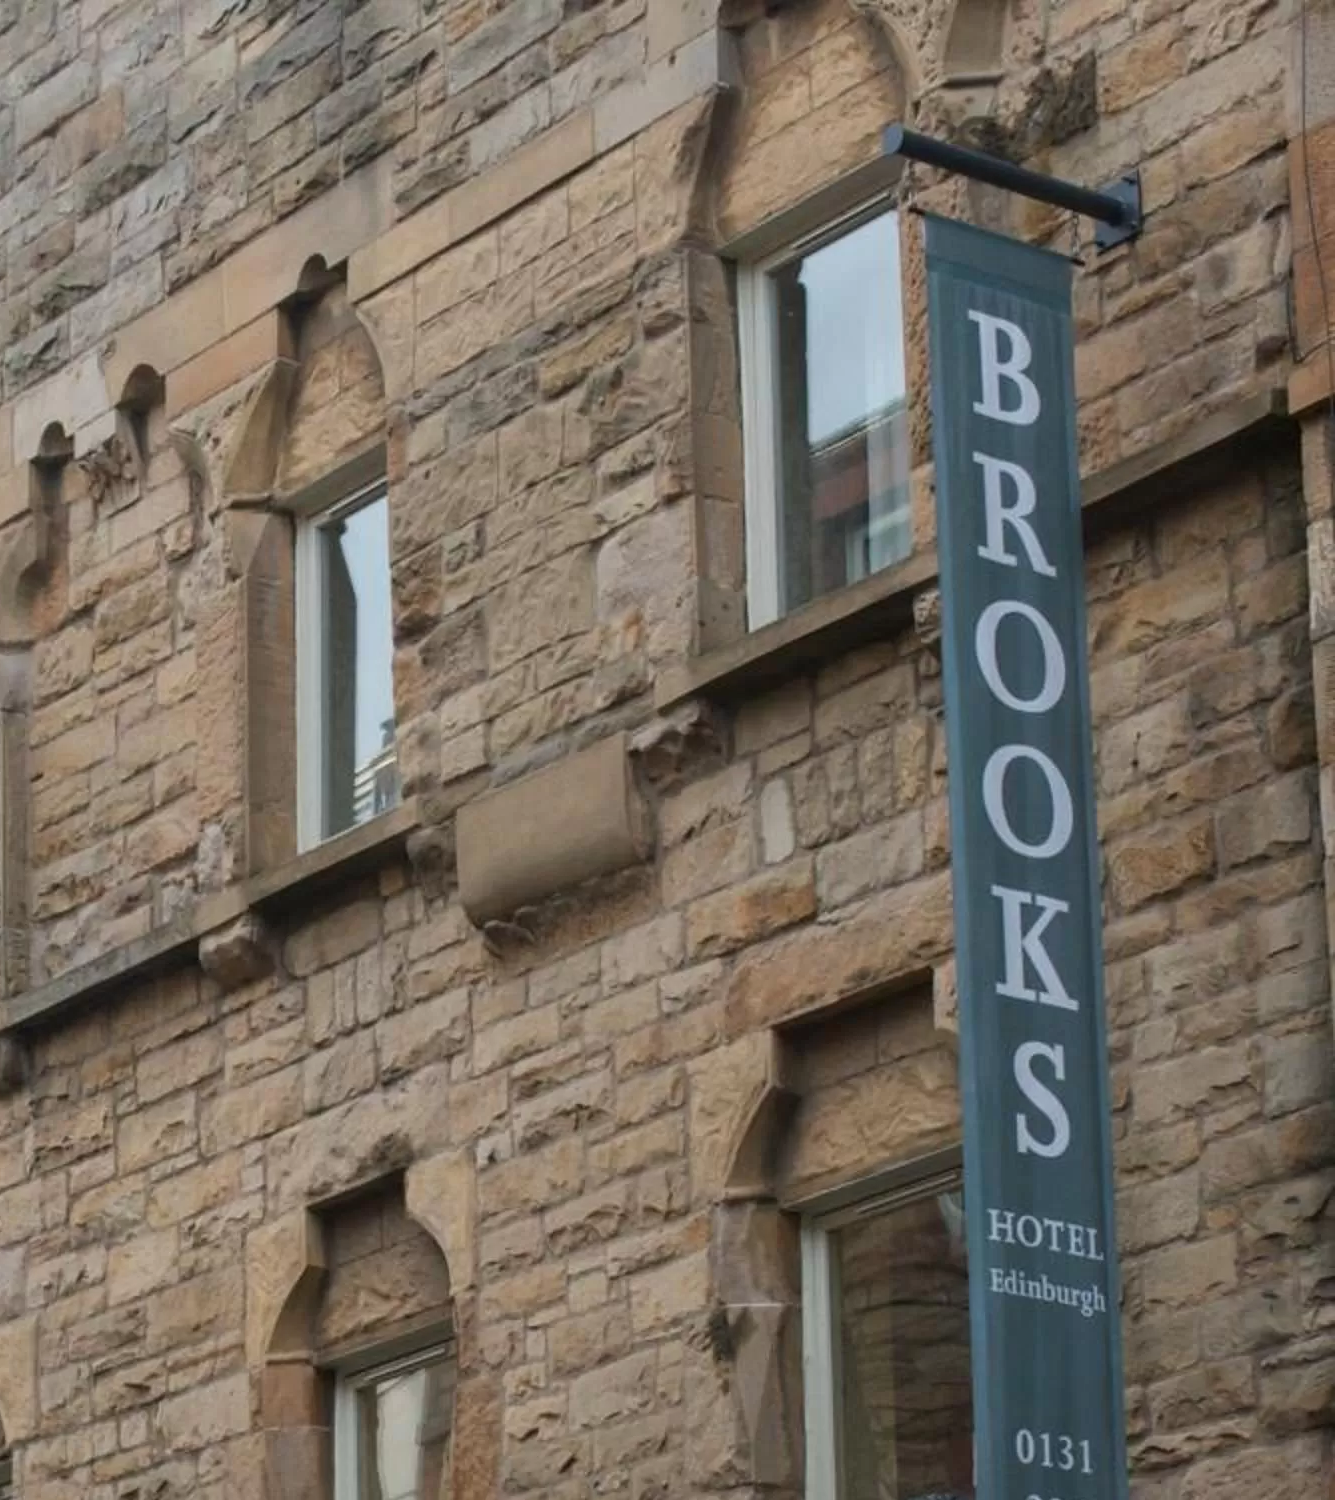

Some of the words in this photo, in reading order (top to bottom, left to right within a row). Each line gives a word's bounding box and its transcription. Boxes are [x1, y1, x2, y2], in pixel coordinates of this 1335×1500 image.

[968, 308, 1079, 1158] BROOKS
[987, 1208, 1104, 1261] HOTEL
[988, 1267, 1107, 1318] Edinburgh
[1015, 1428, 1094, 1474] 0131
